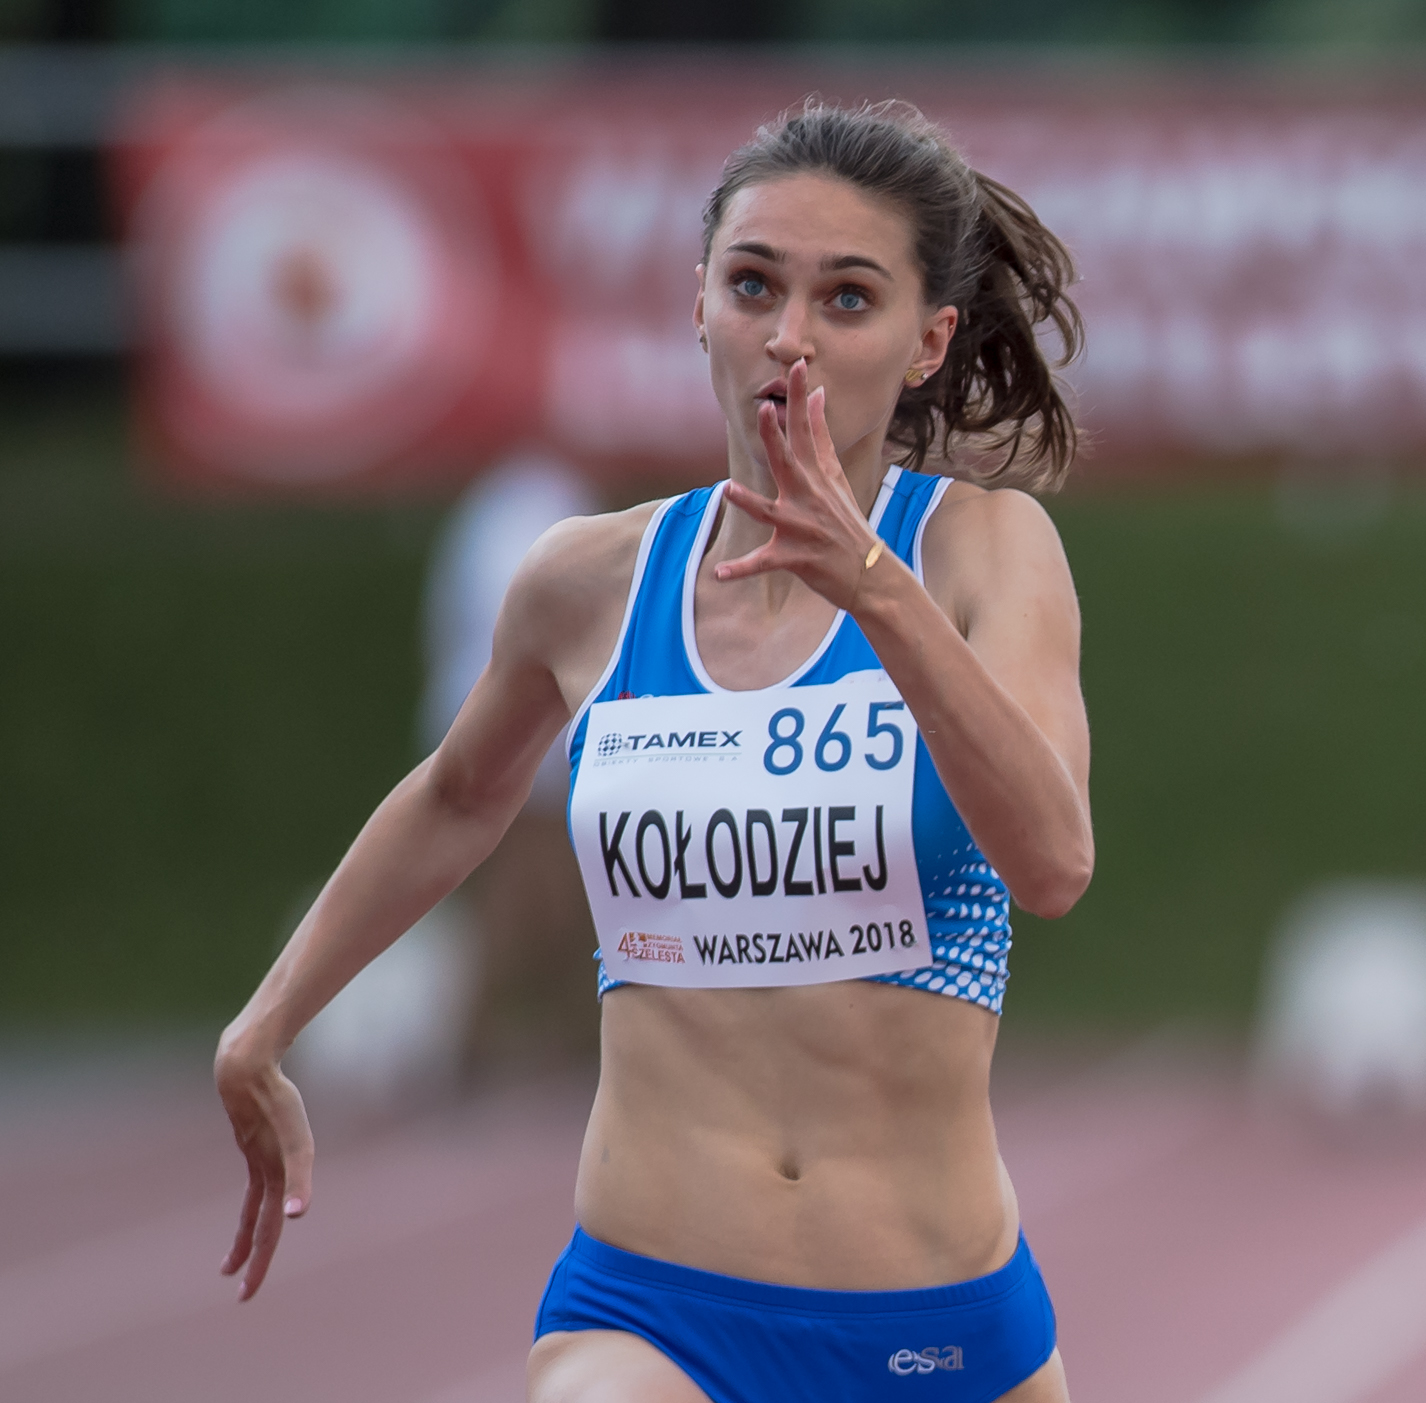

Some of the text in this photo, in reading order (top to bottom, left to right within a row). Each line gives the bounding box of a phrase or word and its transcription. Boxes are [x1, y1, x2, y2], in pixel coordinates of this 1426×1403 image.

[628, 730, 743, 750] TAMEX
[763, 701, 905, 776] 865
[600, 805, 888, 900] KOŁODZIEJ
[693, 920, 916, 965] WARSZAWA 2018
